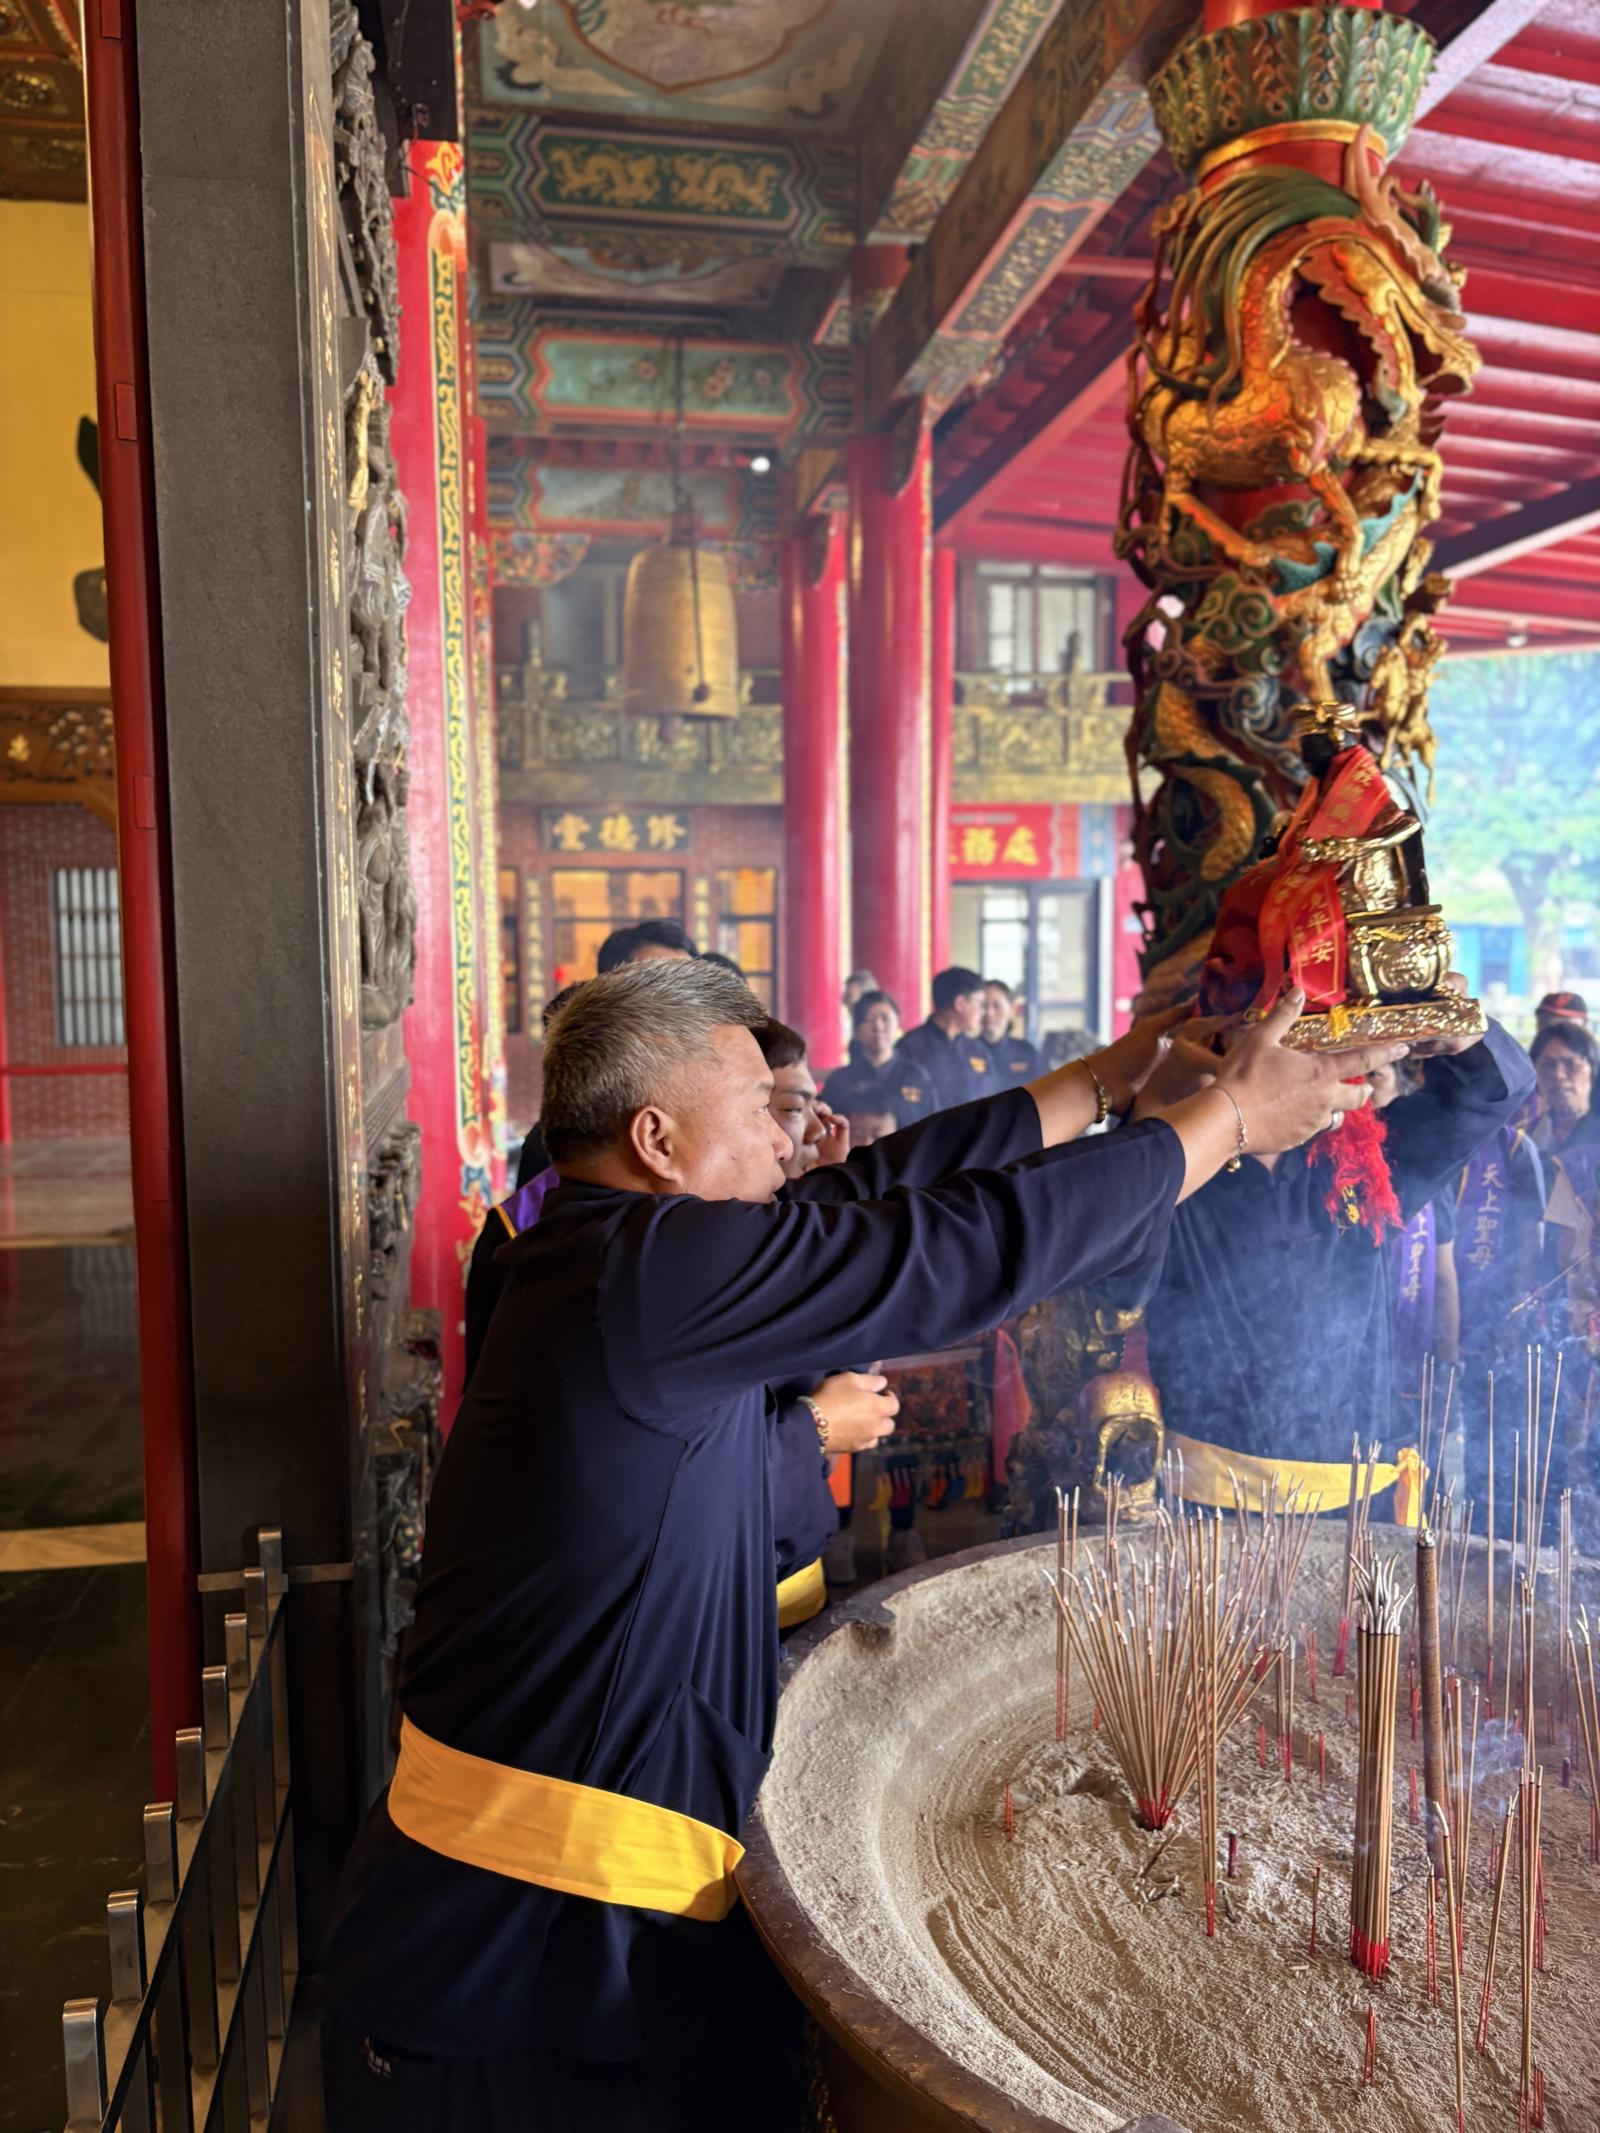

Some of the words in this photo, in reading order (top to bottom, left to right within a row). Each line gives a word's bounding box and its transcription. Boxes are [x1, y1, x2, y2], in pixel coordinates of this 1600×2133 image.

[947, 825, 1039, 866] 務處
[1402, 1204, 1430, 1302] 上聖母
[1467, 1163, 1504, 1270] 天上聖母
